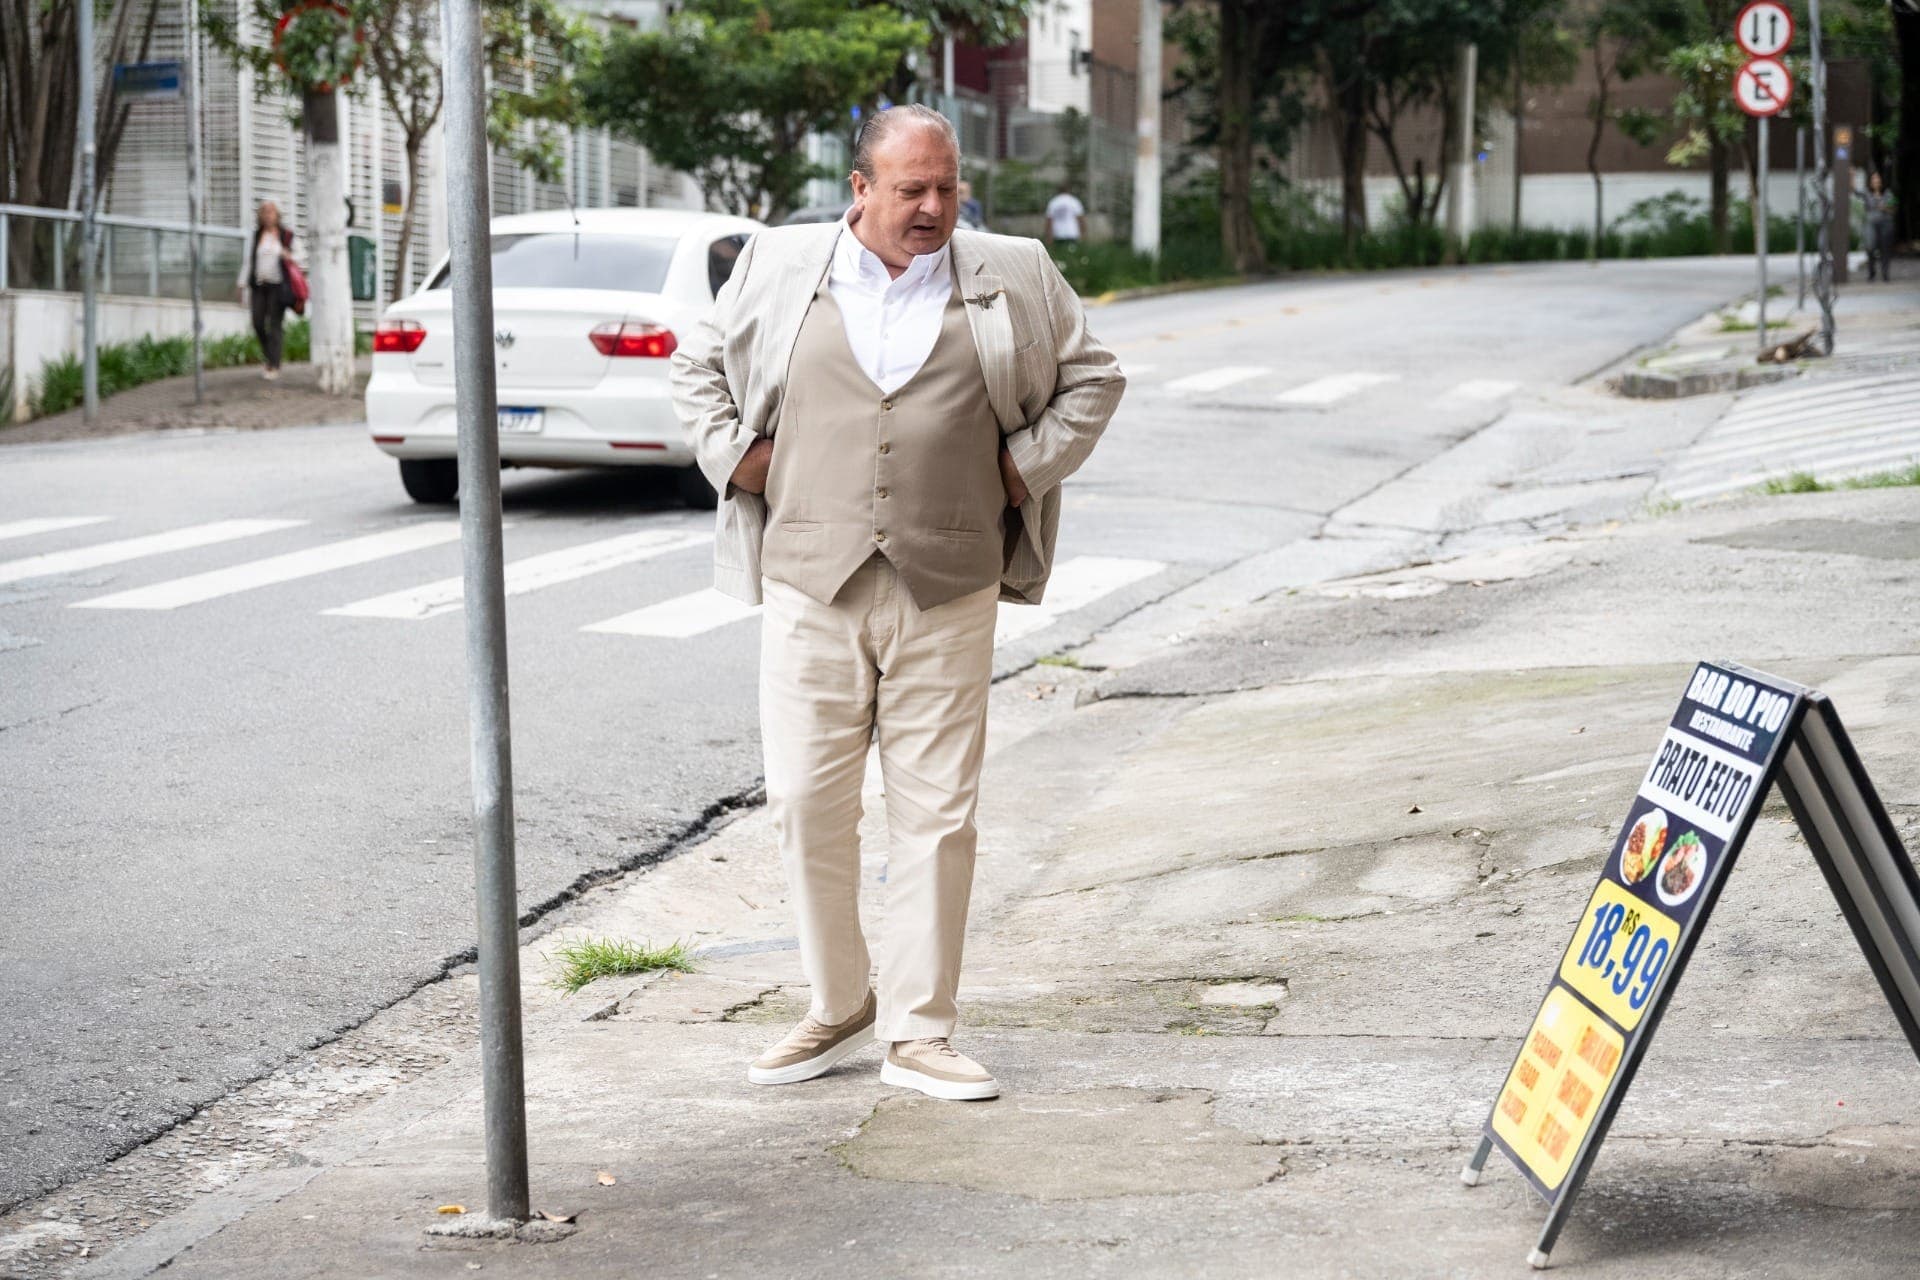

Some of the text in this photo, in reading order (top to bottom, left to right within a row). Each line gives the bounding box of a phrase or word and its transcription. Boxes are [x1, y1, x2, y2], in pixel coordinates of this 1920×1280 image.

[1686, 667, 1790, 733] BAR DO PIO
[1689, 709, 1756, 752] RESTAURANTE
[1649, 739, 1752, 823] PRATO FEITO
[1577, 902, 1669, 1010] 18,99
